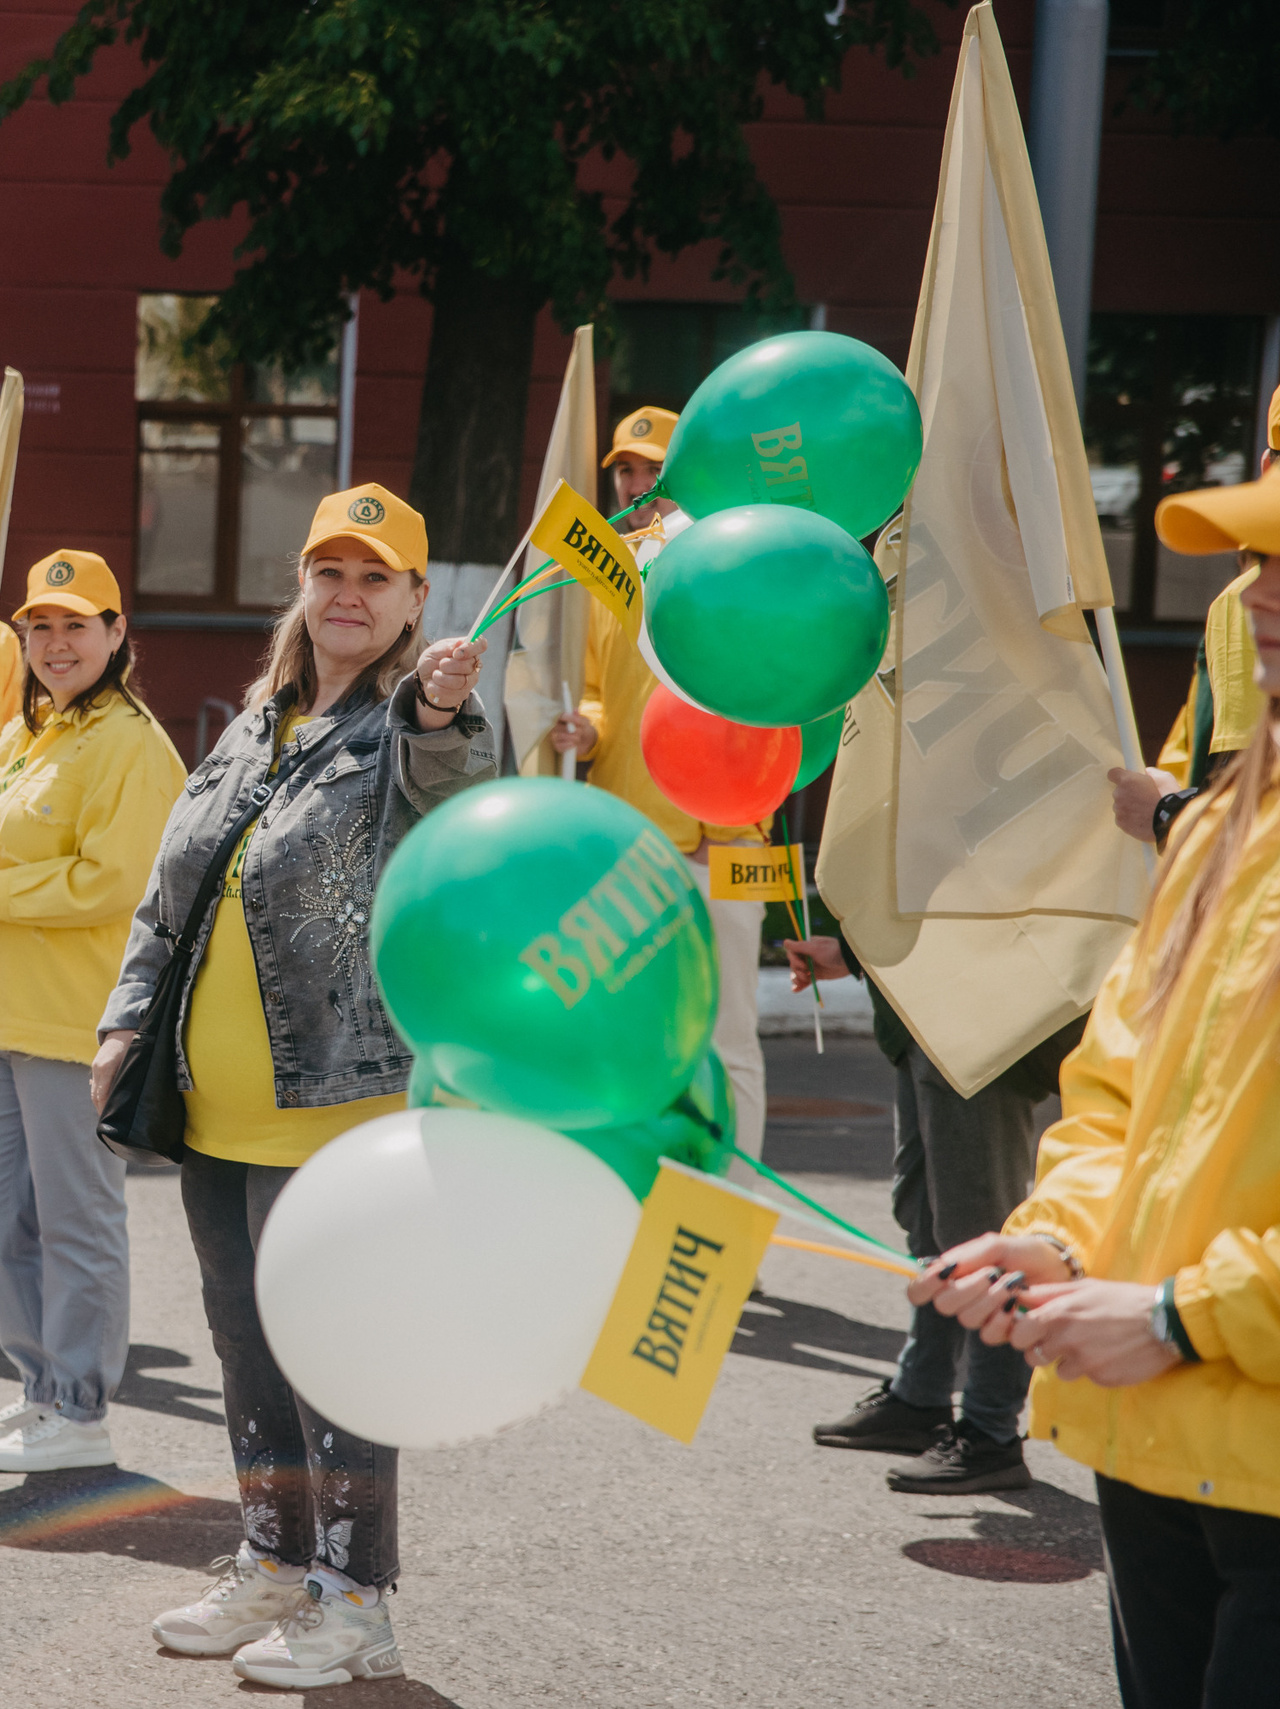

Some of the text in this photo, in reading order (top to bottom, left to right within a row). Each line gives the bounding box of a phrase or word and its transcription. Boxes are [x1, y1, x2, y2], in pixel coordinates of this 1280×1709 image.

[751, 421, 818, 511] ВЯТ
[562, 516, 636, 611] ВЯТИЧ
[877, 521, 1102, 856] ТИЧ
[518, 828, 694, 1010] ВЯТИЧ
[631, 1224, 725, 1379] ВЯТИЧ
